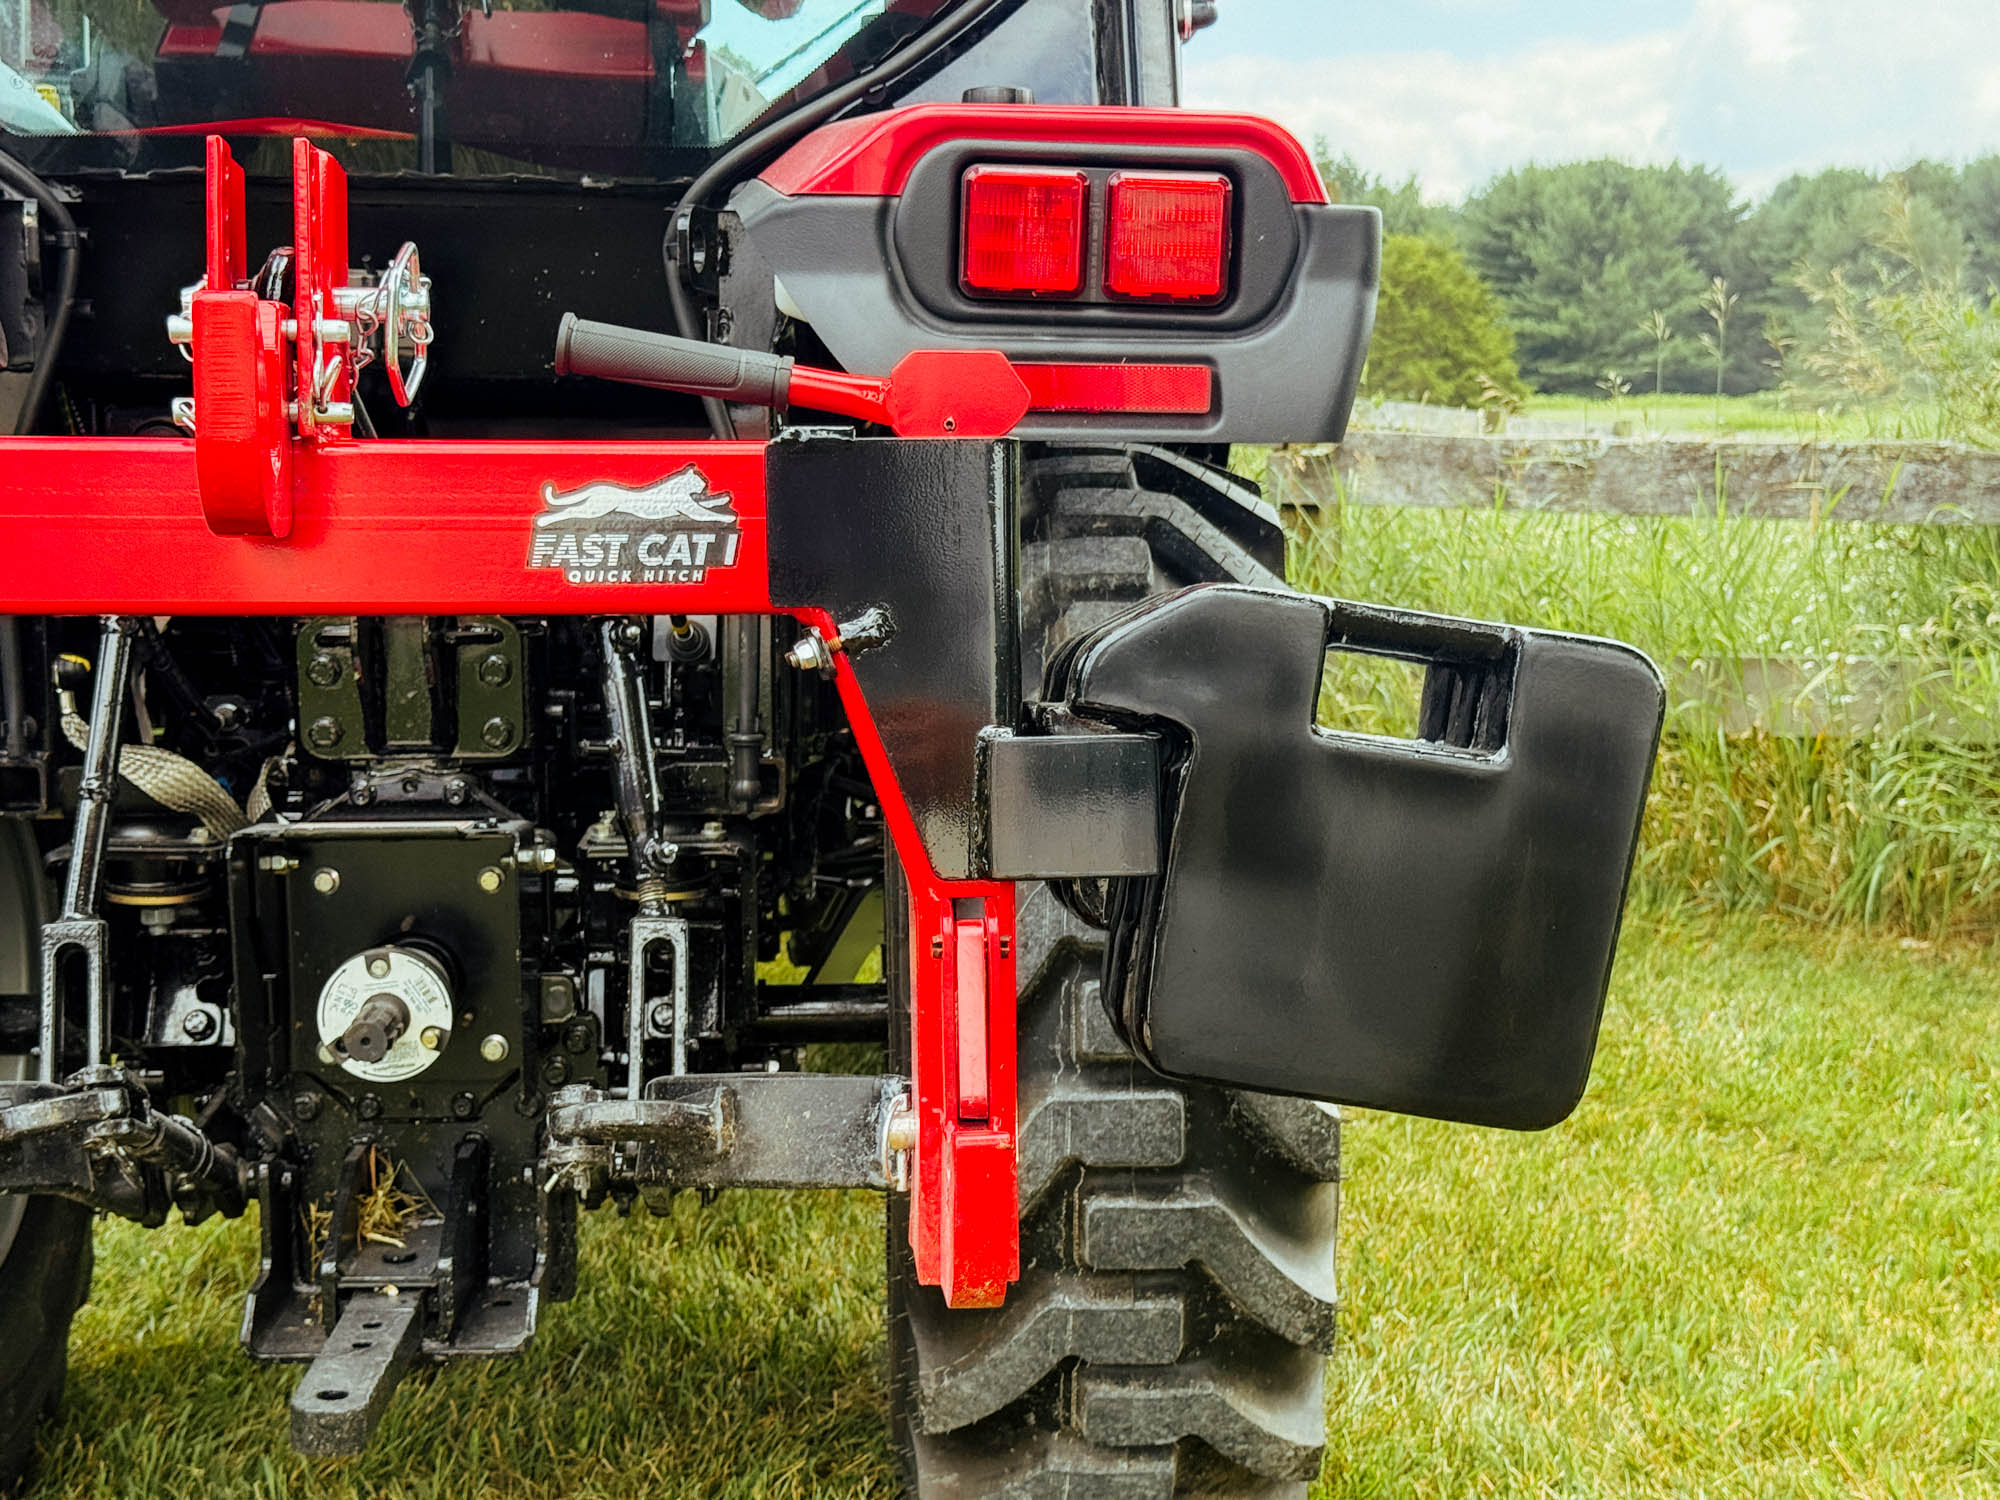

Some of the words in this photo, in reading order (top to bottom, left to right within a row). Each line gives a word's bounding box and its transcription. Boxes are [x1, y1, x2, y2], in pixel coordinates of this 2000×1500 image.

[531, 533, 630, 567] FAST
[637, 533, 716, 567] CAT
[724, 533, 739, 566] I
[568, 569, 633, 583] QUICK
[644, 569, 705, 583] HITCH
